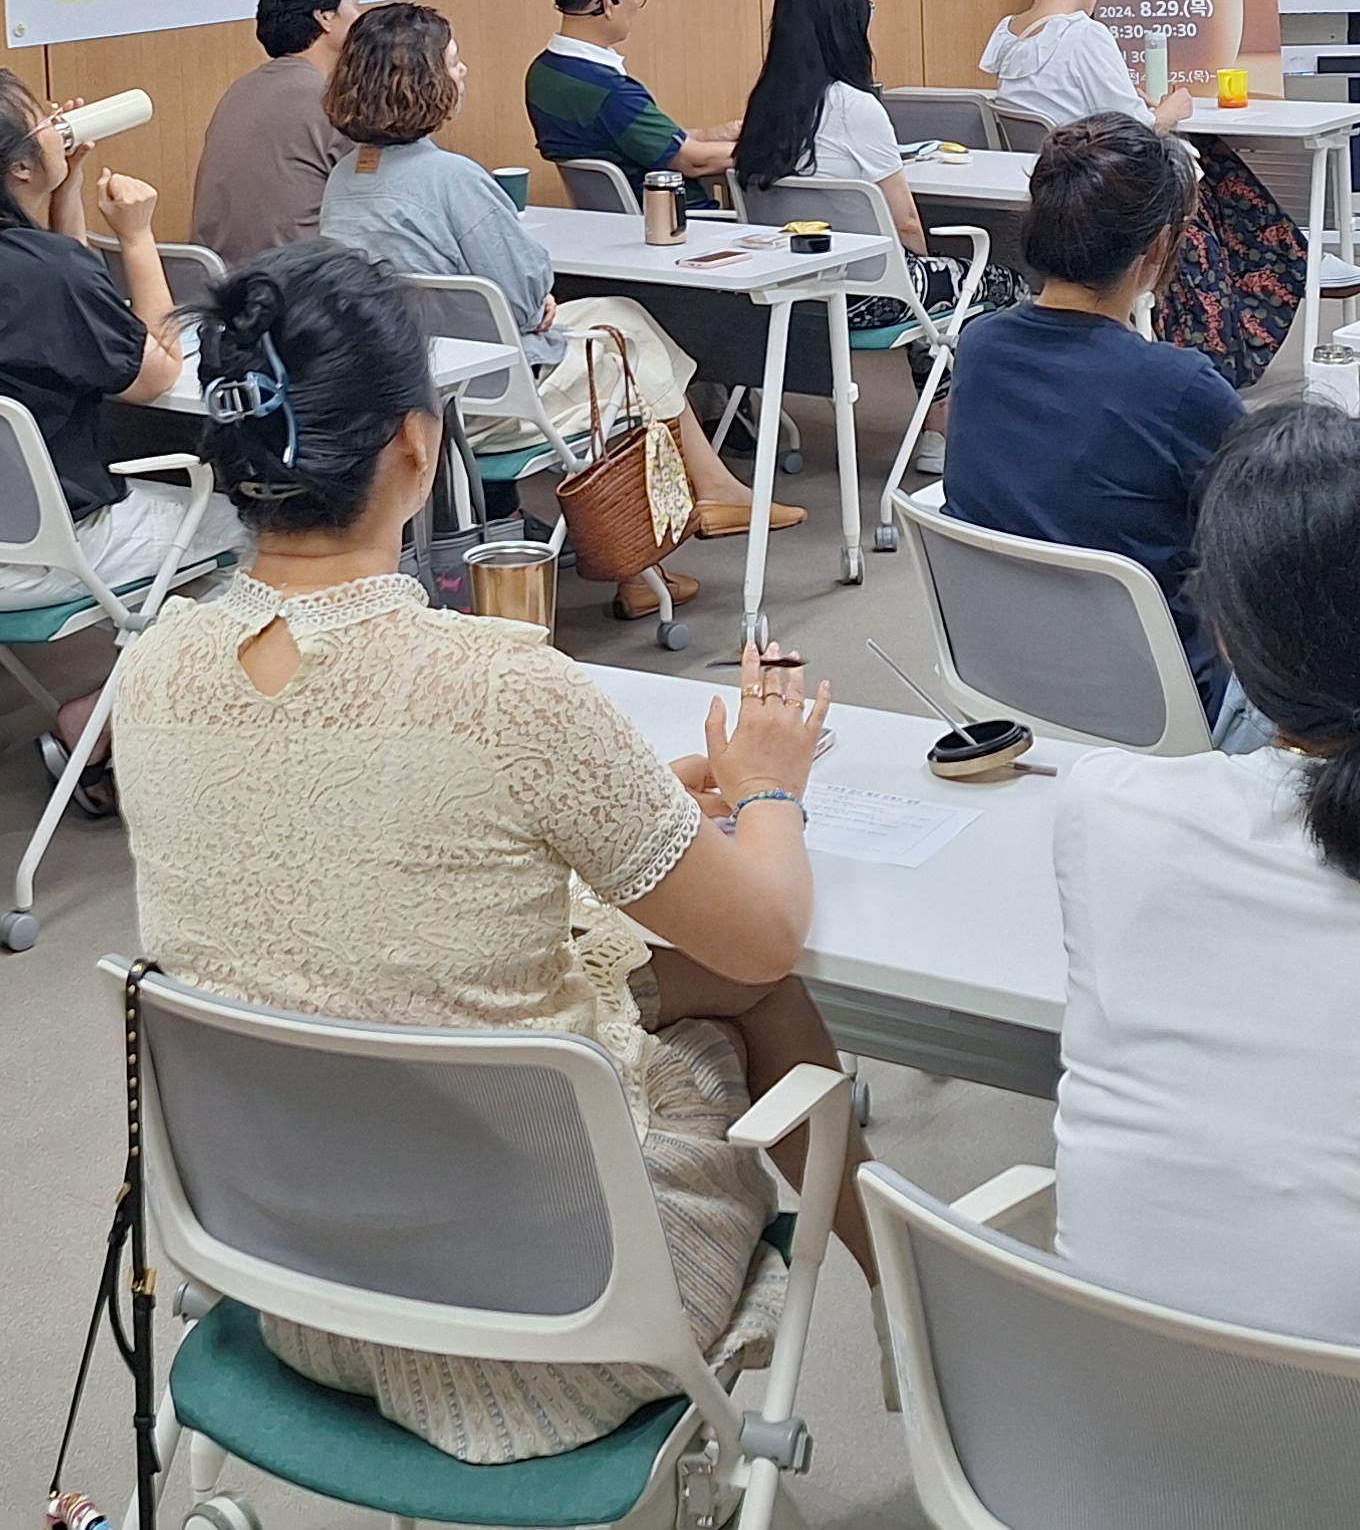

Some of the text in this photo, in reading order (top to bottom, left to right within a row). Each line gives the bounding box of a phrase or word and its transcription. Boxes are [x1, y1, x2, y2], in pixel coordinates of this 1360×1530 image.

[1099, 0, 1213, 18] 2024. 8.29.(목)
[1109, 23, 1197, 39] 8:30~20:30
